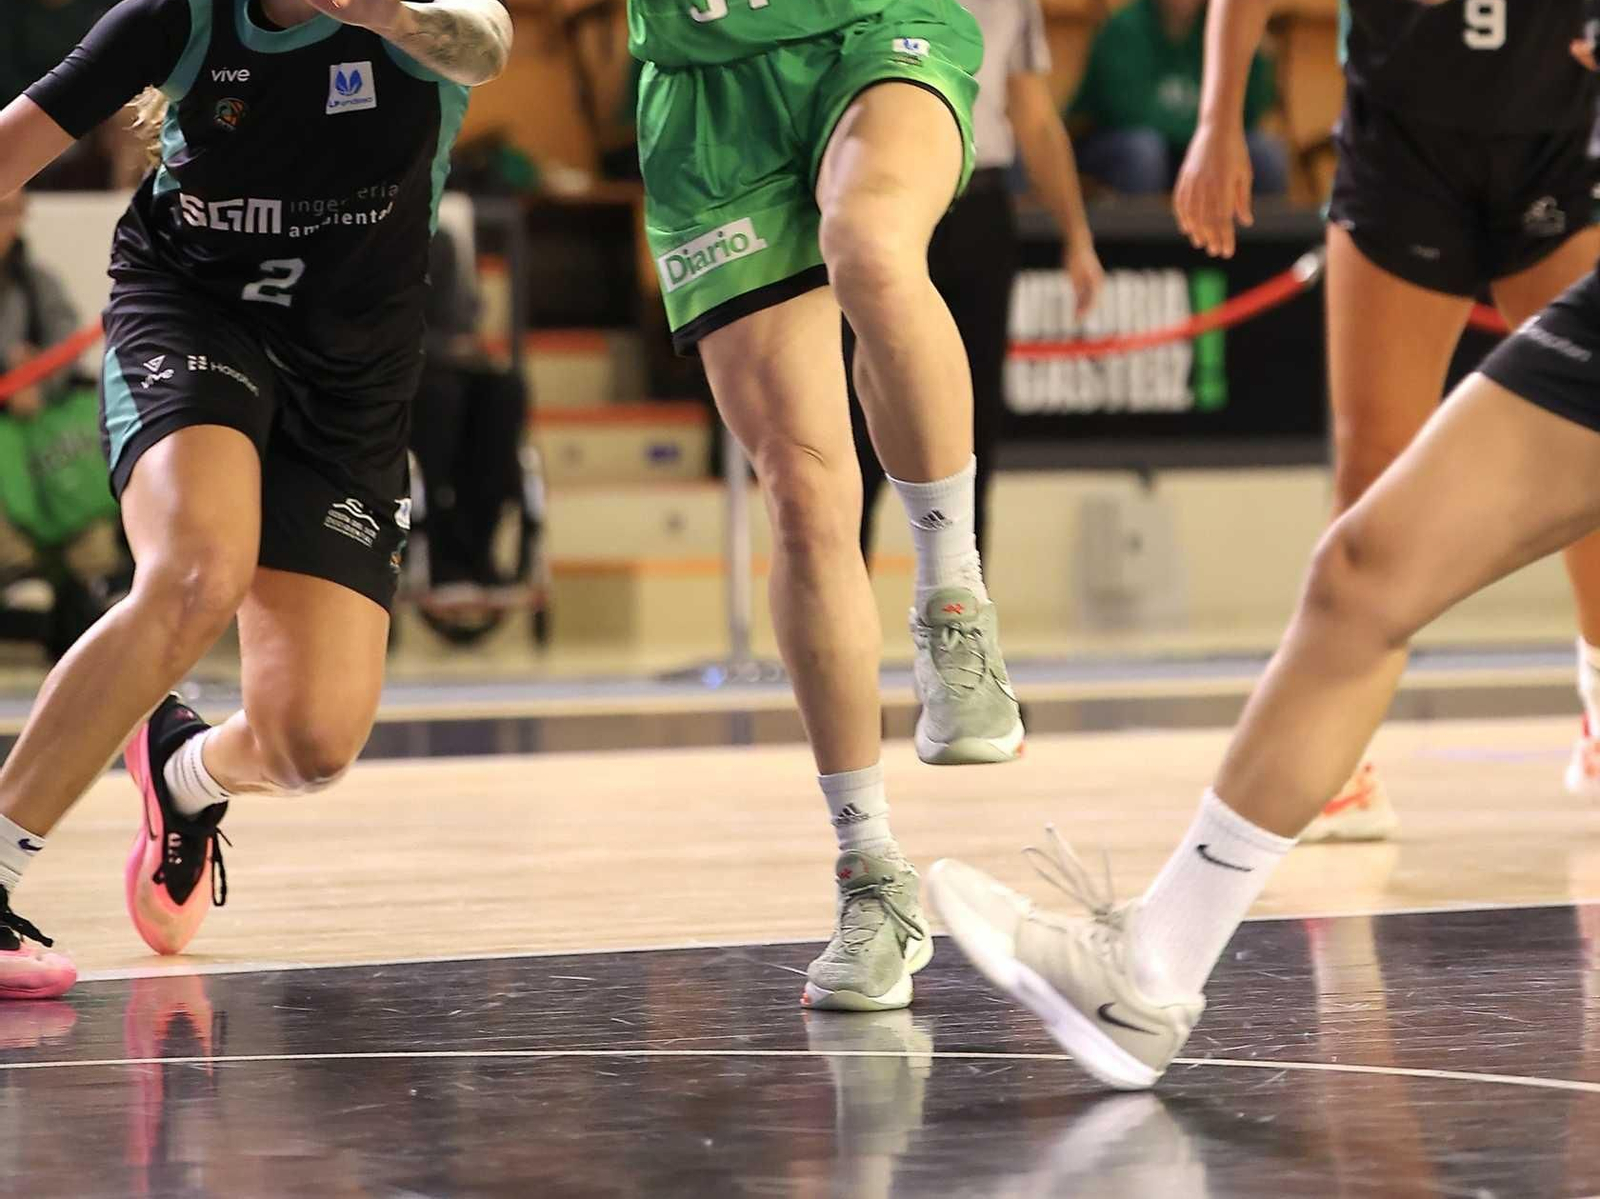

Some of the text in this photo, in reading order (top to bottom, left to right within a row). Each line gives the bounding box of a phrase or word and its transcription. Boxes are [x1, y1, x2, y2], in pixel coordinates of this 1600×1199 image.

[211, 67, 250, 82] vive
[179, 192, 282, 234] SGM
[665, 231, 749, 285] Diario
[241, 258, 306, 307] 2
